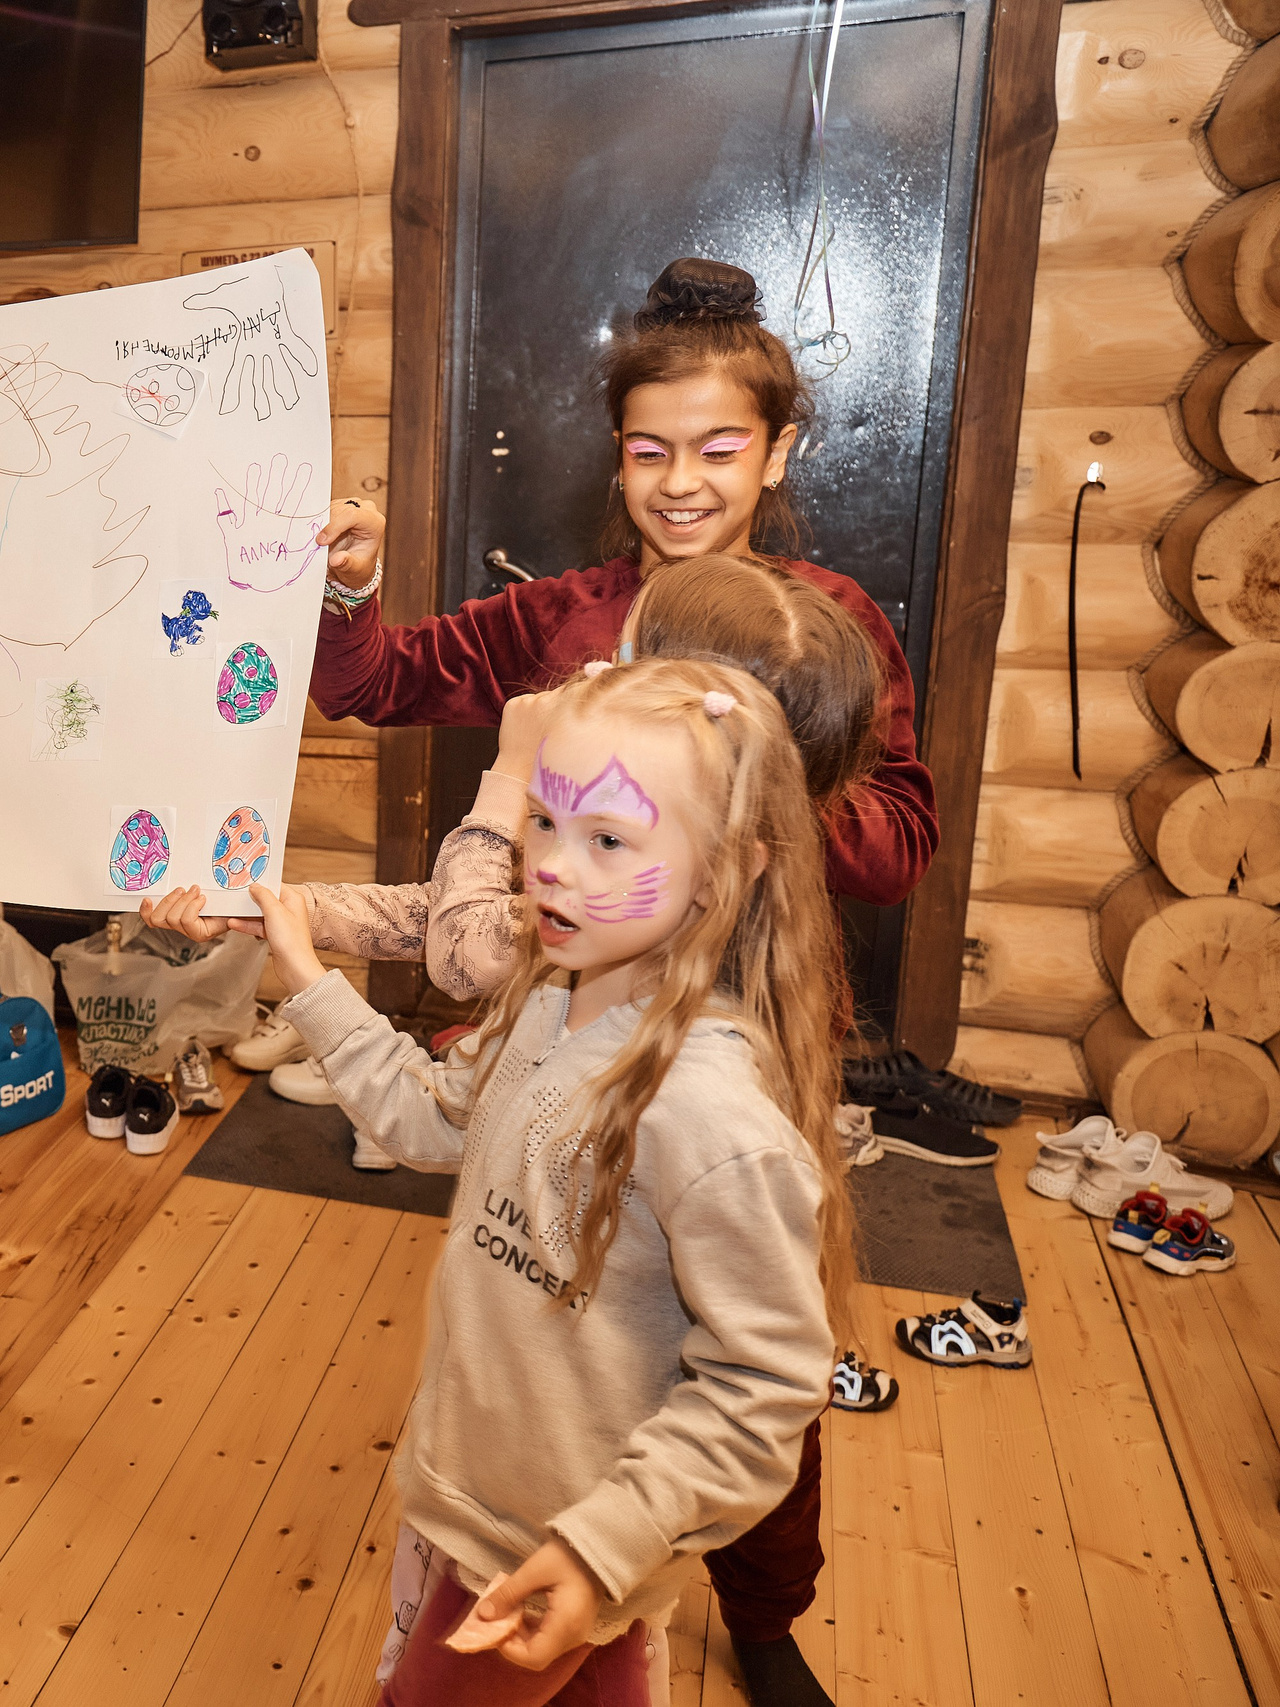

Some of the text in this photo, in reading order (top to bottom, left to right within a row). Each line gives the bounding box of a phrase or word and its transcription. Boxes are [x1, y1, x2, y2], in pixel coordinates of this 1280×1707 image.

[200, 255, 239, 267] ШУМЕТЬ
[0, 1069, 55, 1108] SPORT
[483, 1188, 533, 1241] LIVE
